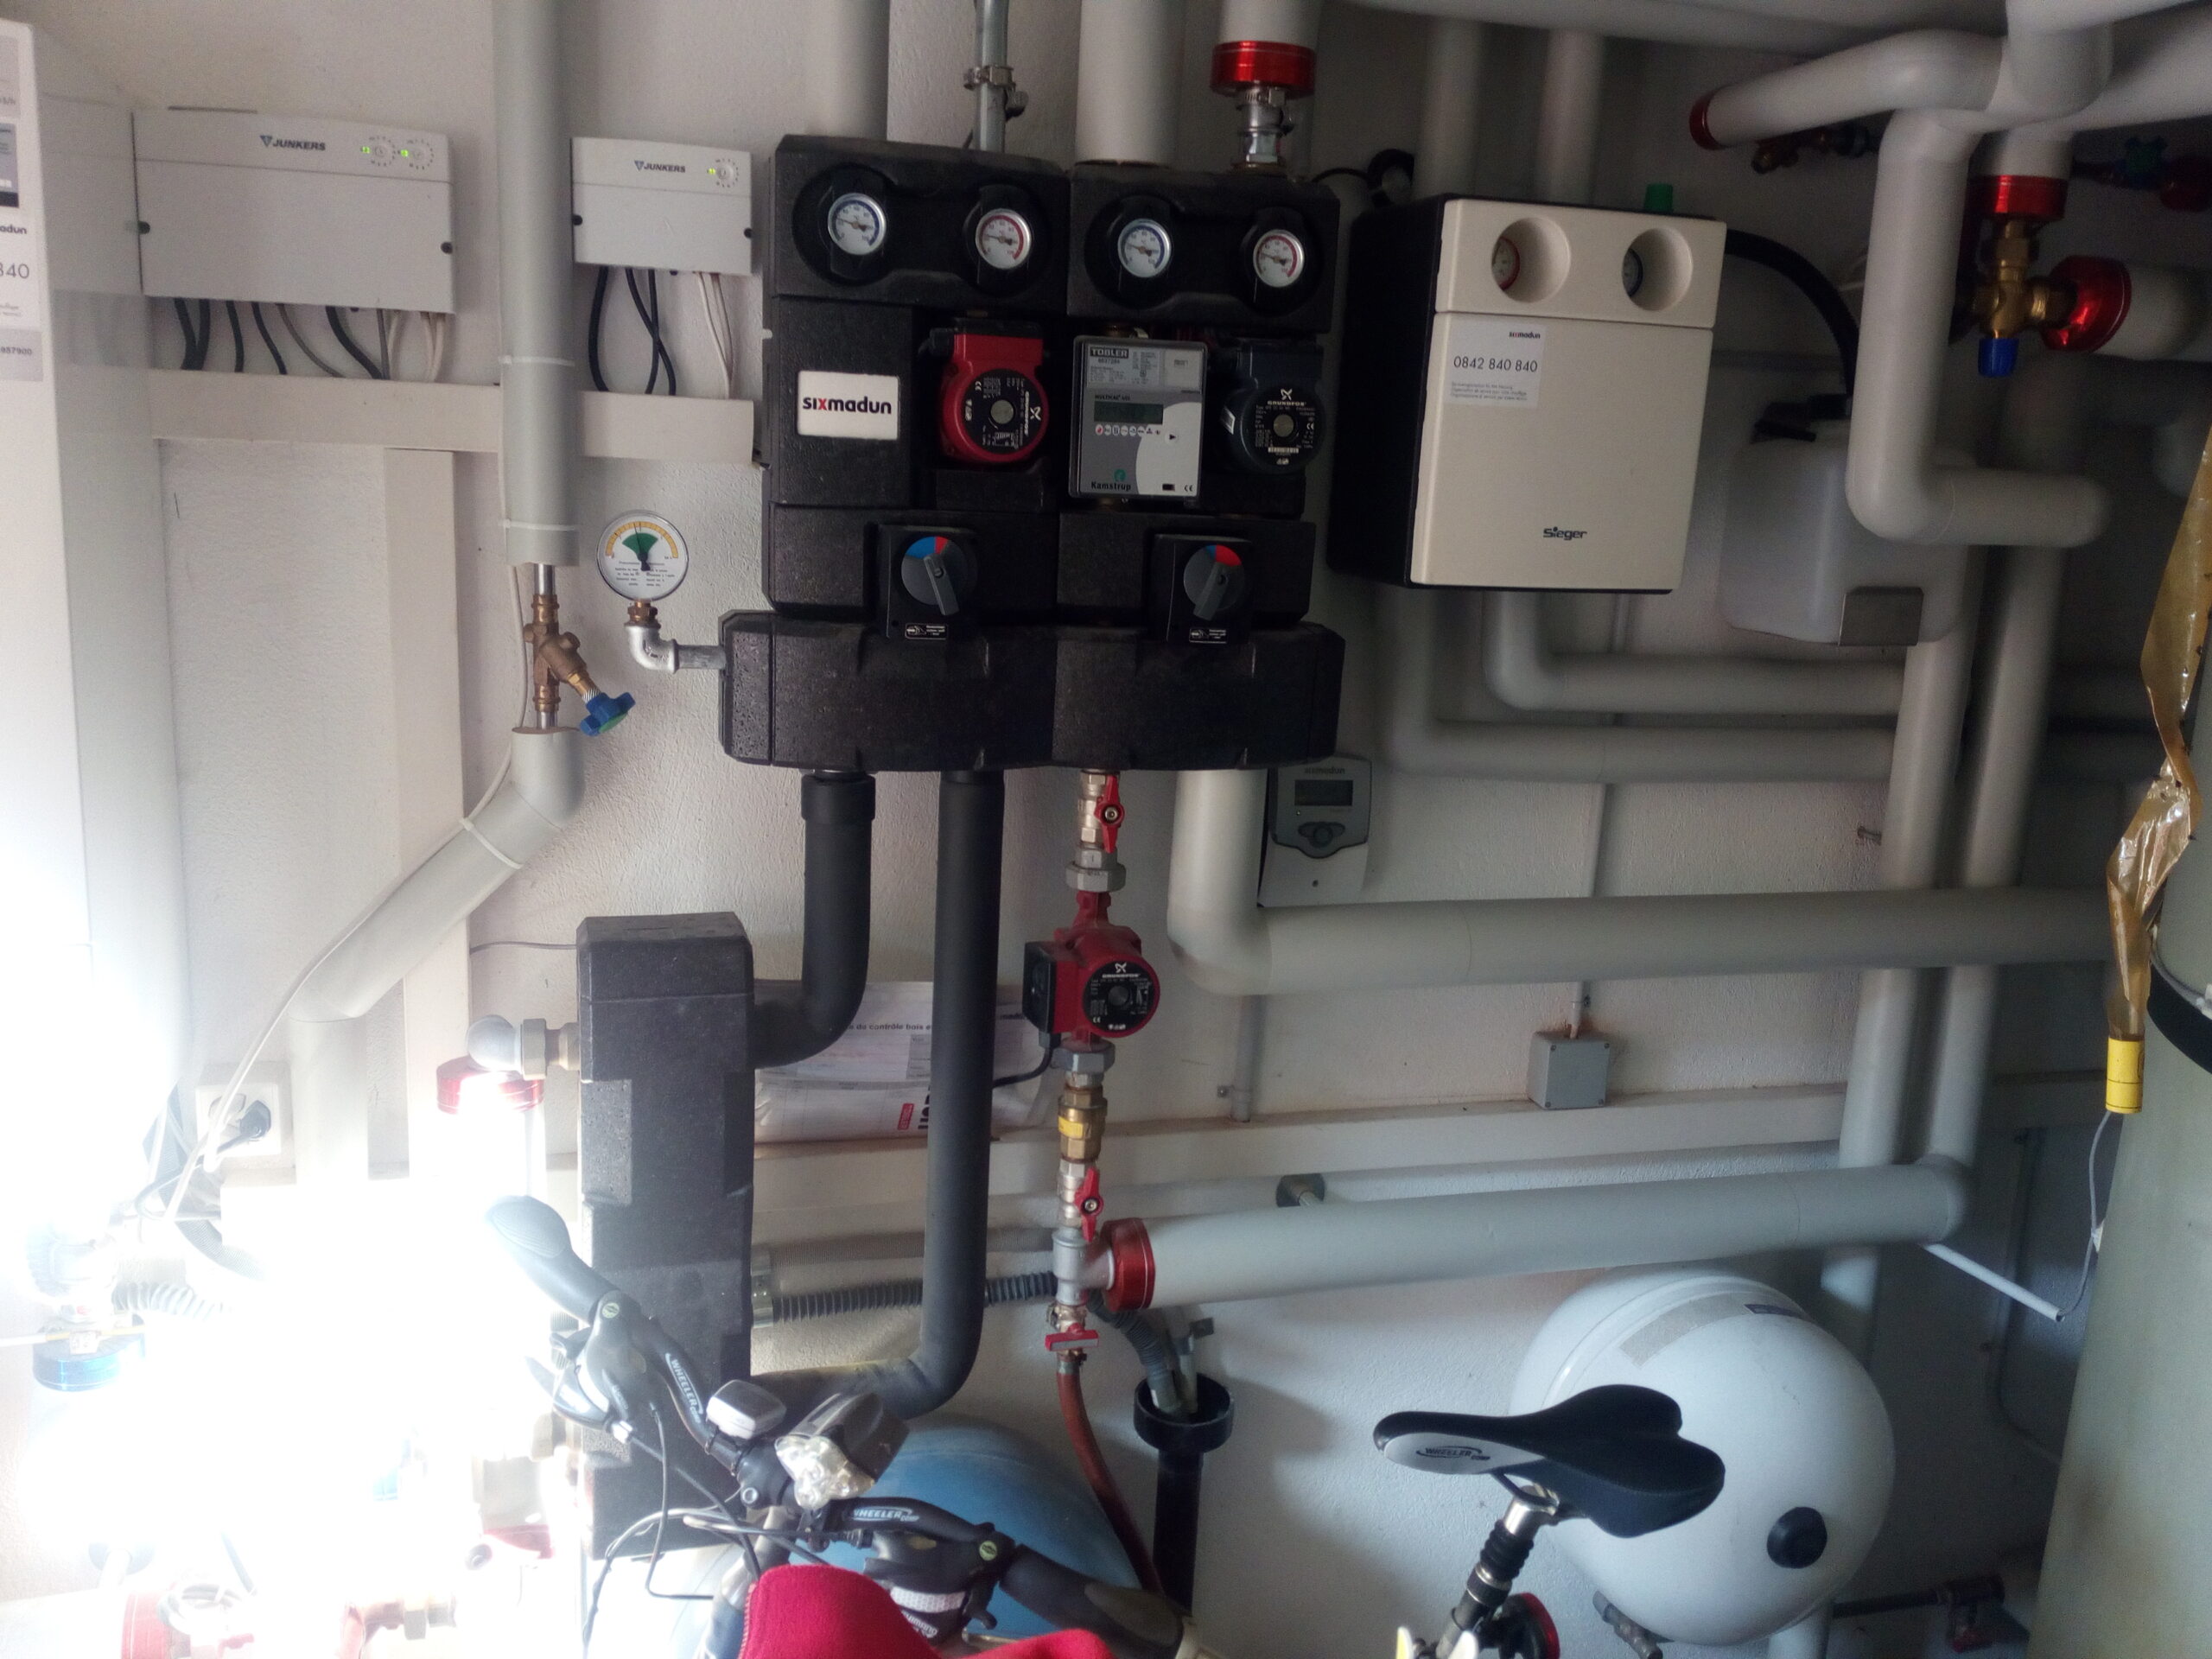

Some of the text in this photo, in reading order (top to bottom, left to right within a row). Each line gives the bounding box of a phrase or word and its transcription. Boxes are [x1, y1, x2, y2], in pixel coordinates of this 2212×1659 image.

[272, 138, 326, 151] JUNKERS
[644, 162, 686, 173] JUNKERS
[1091, 347, 1128, 359] TOBLER
[1453, 356, 1538, 373] 0842 840 840
[803, 396, 892, 415] sixmadun
[1090, 480, 1132, 492] Kamstrup
[1542, 526, 1588, 541] Sieger
[671, 1358, 699, 1409] WHEELER
[1425, 1447, 1472, 1457] WHEELER
